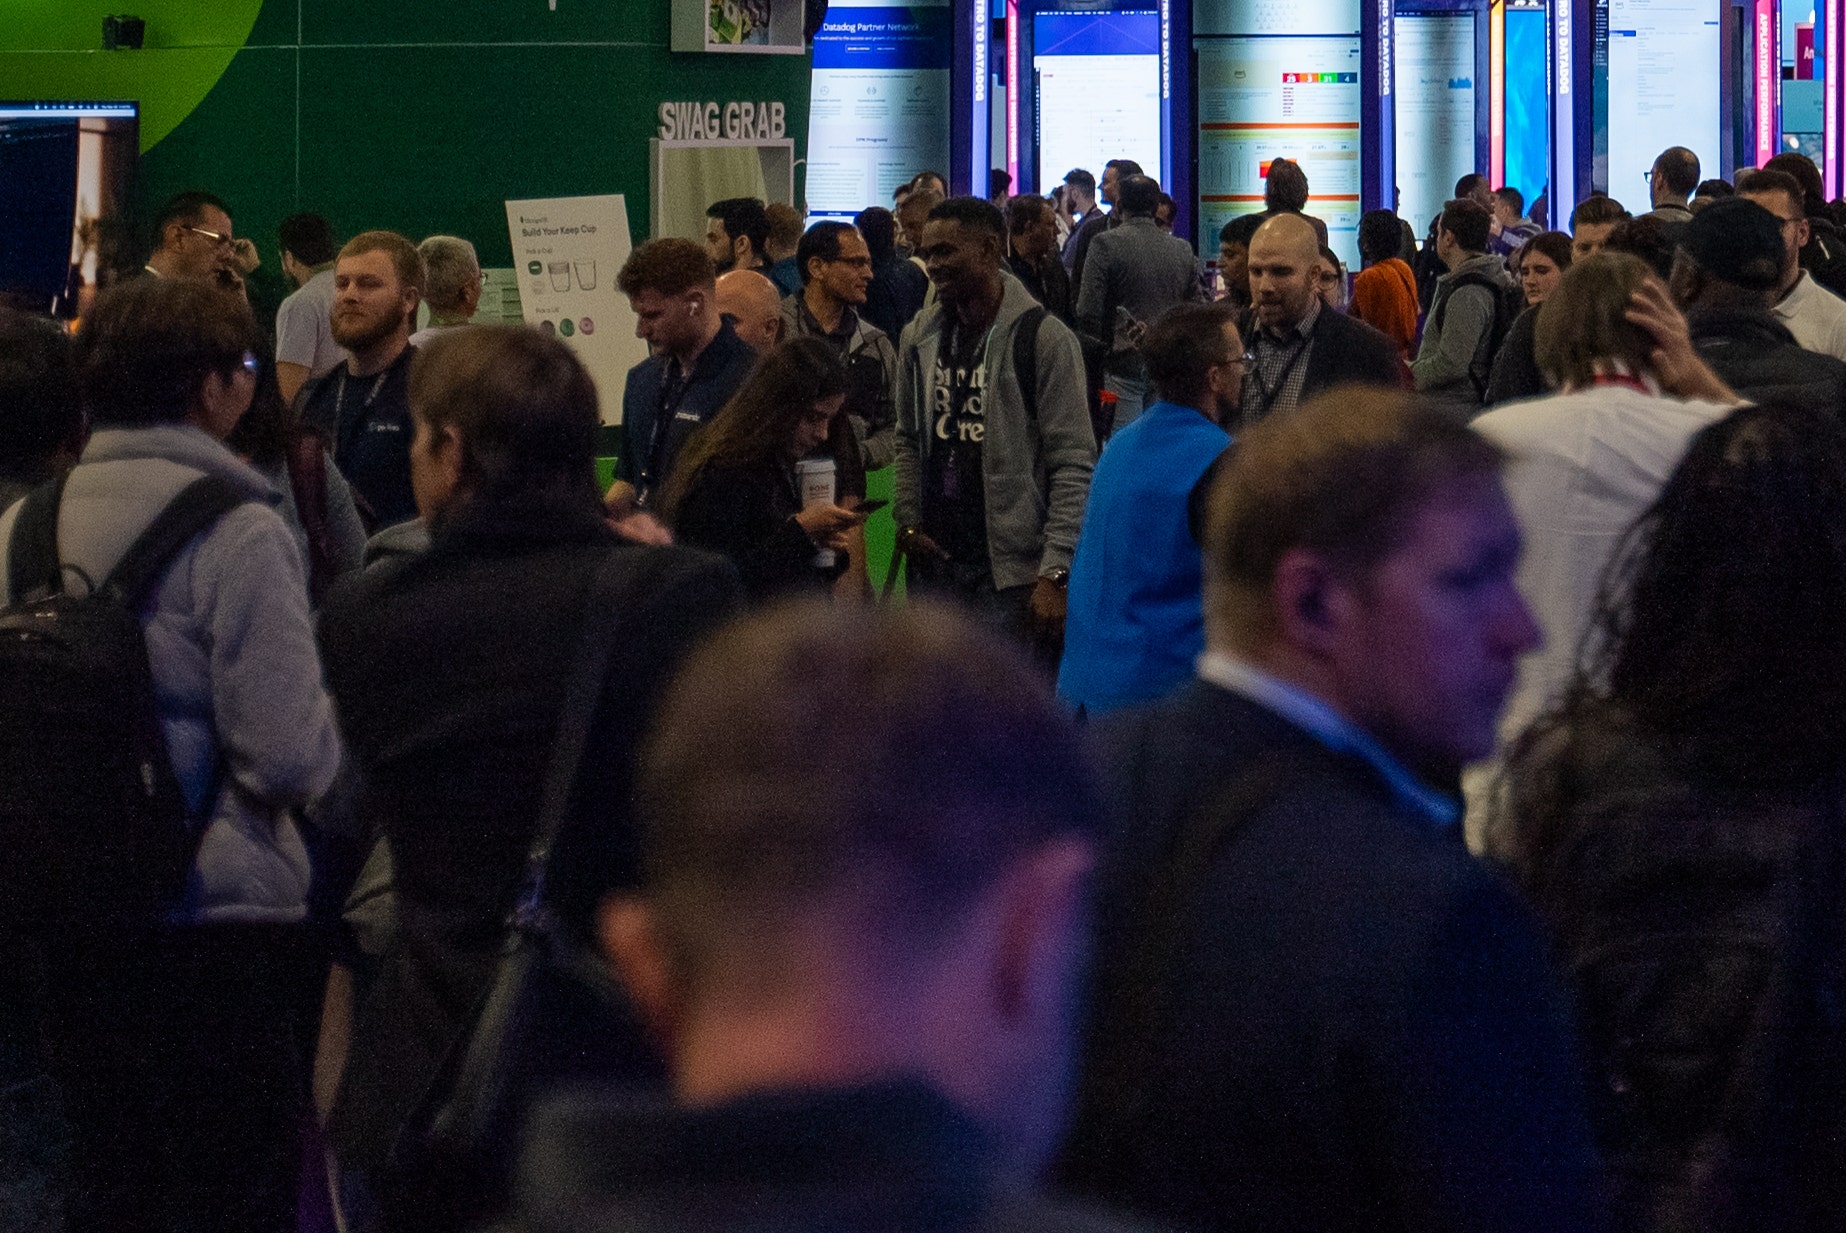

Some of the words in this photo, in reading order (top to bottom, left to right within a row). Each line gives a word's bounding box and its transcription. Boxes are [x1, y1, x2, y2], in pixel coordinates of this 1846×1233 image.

[823, 22, 856, 33] Datadog
[857, 23, 886, 31] Partner
[887, 23, 919, 31] Network
[975, 25, 985, 42] TO
[1162, 22, 1169, 39] TO
[1381, 19, 1389, 36] TO
[1558, 19, 1568, 36] TO
[1760, 13, 1768, 77] APPLICATION
[975, 44, 985, 102] DATADOG
[1558, 38, 1569, 94] DATADOG
[658, 102, 720, 140] SWAG
[723, 102, 786, 140] GRAB
[1760, 79, 1769, 150] PERFORMANCE
[1828, 87, 1836, 160] MONITORING
[522, 228, 542, 237] Build
[542, 227, 559, 236] Your
[560, 226, 579, 236] Keep
[580, 225, 597, 235] Cup
